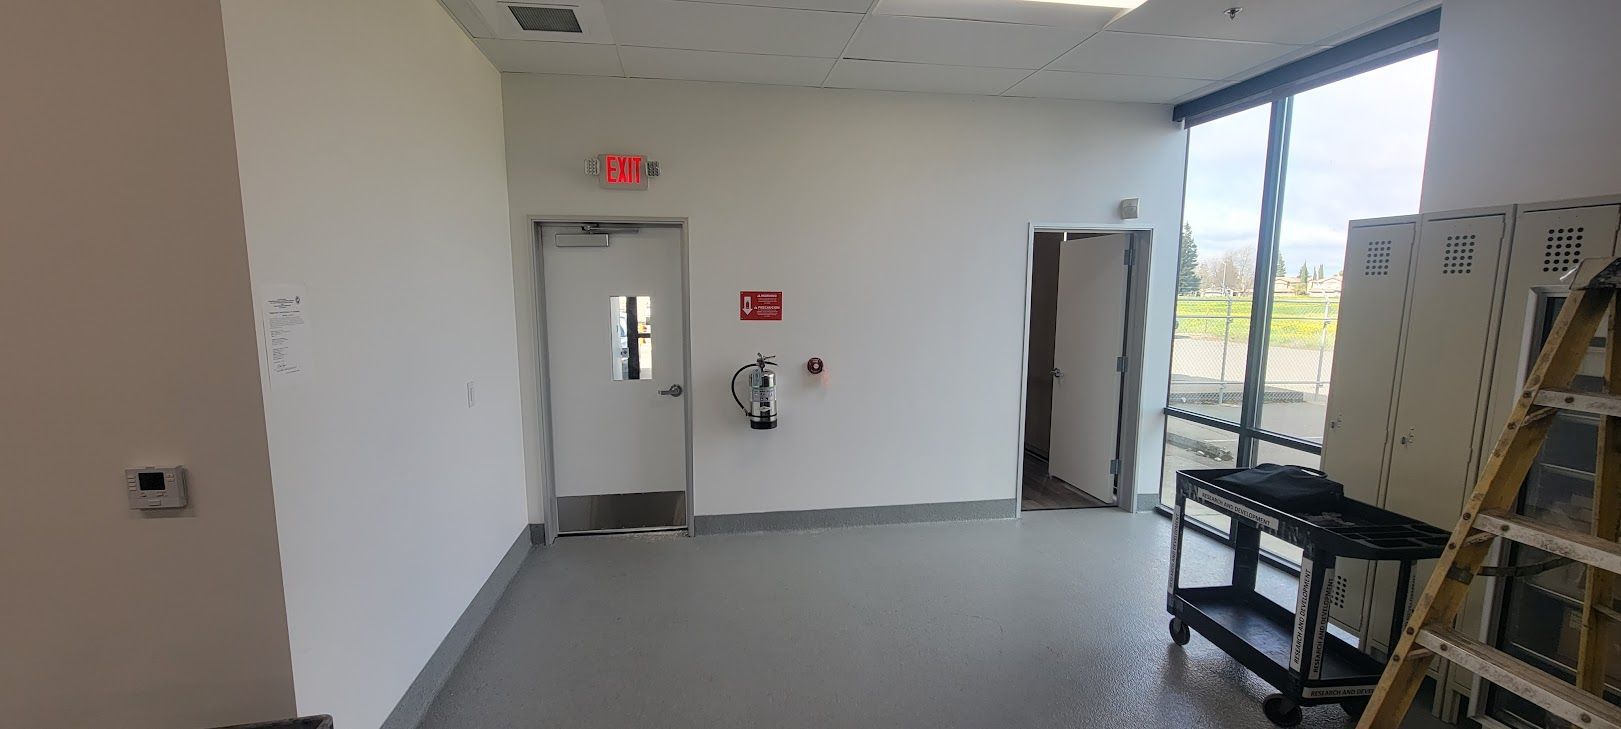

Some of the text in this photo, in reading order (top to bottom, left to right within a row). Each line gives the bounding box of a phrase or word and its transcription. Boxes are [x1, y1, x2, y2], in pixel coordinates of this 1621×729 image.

[606, 156, 641, 183] EXIT
[1202, 492, 1271, 526] RESEARCH AND DEVELOPMENT
[1294, 632, 1303, 664] RESEARCH
[1301, 569, 1311, 617] DEVELOPMENT
[1313, 641, 1323, 673] RESEARCH
[1321, 578, 1333, 625] DEVELOPMENT
[1311, 689, 1341, 697] RESEARCH
